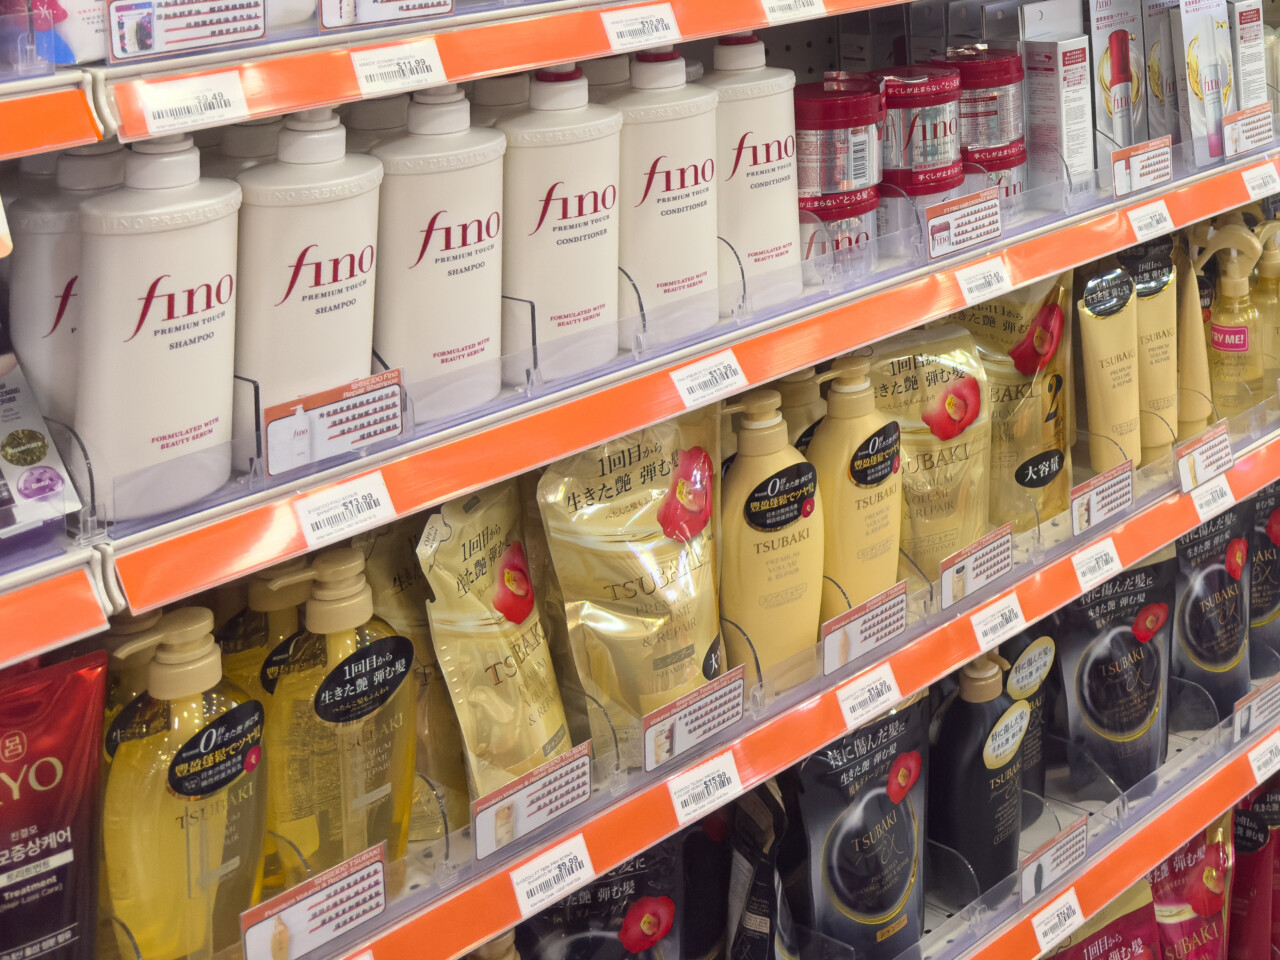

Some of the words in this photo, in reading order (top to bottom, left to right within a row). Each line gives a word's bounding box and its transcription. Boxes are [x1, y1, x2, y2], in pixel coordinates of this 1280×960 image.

[640, 17, 665, 28] $10.99
[396, 58, 426, 70] $11.99
[725, 131, 796, 182] fino
[746, 166, 776, 178] PREMIUM
[777, 161, 792, 172] TOUCH
[634, 155, 715, 208] fino
[656, 191, 690, 204] PREMIUM
[691, 186, 710, 198] TOUCH
[750, 175, 791, 190] CONDITIONER
[528, 181, 617, 237] fino
[660, 200, 709, 217] CONDITIONER
[408, 210, 501, 270] fino
[556, 228, 608, 246] CONDITIONER
[274, 244, 375, 307] fino
[447, 260, 486, 277] SHAMPOO
[656, 276, 694, 289] FORMULATED
[695, 271, 708, 282] WITH
[663, 285, 685, 295] BEAUTY
[685, 279, 704, 291] SERUM
[123, 273, 234, 343] fino
[315, 298, 357, 315] SHAMPOO
[154, 320, 200, 337] PREMIUM
[201, 310, 227, 327] TOUCH
[169, 331, 215, 350] SHAMPOO
[1227, 333, 1245, 345] ME!
[709, 363, 733, 379] $13.99
[1045, 373, 1064, 424] 2
[151, 424, 203, 444] FORMULATED
[203, 417, 220, 431] WITH
[160, 435, 189, 451] BEAUTY
[190, 427, 214, 444] SERUM
[596, 442, 663, 478] 1回目から
[1024, 454, 1060, 483] 大容量
[341, 492, 374, 511] $13.99
[566, 471, 633, 515] 生きた艶
[854, 483, 897, 511] TSUBAKI
[753, 527, 811, 555] TSUBAKI
[603, 544, 704, 602] TSUBAKI
[1200, 583, 1240, 613] TSUBAKI
[342, 652, 393, 681] 1回目から
[1100, 646, 1145, 677] TSUBAKI
[319, 677, 369, 706] 生きた艶
[373, 658, 407, 686] 弾む髪
[0, 756, 64, 807] YO
[851, 809, 898, 853] TSUBAKI
[557, 855, 579, 871] $9.99
[4, 874, 58, 901] Treatment
